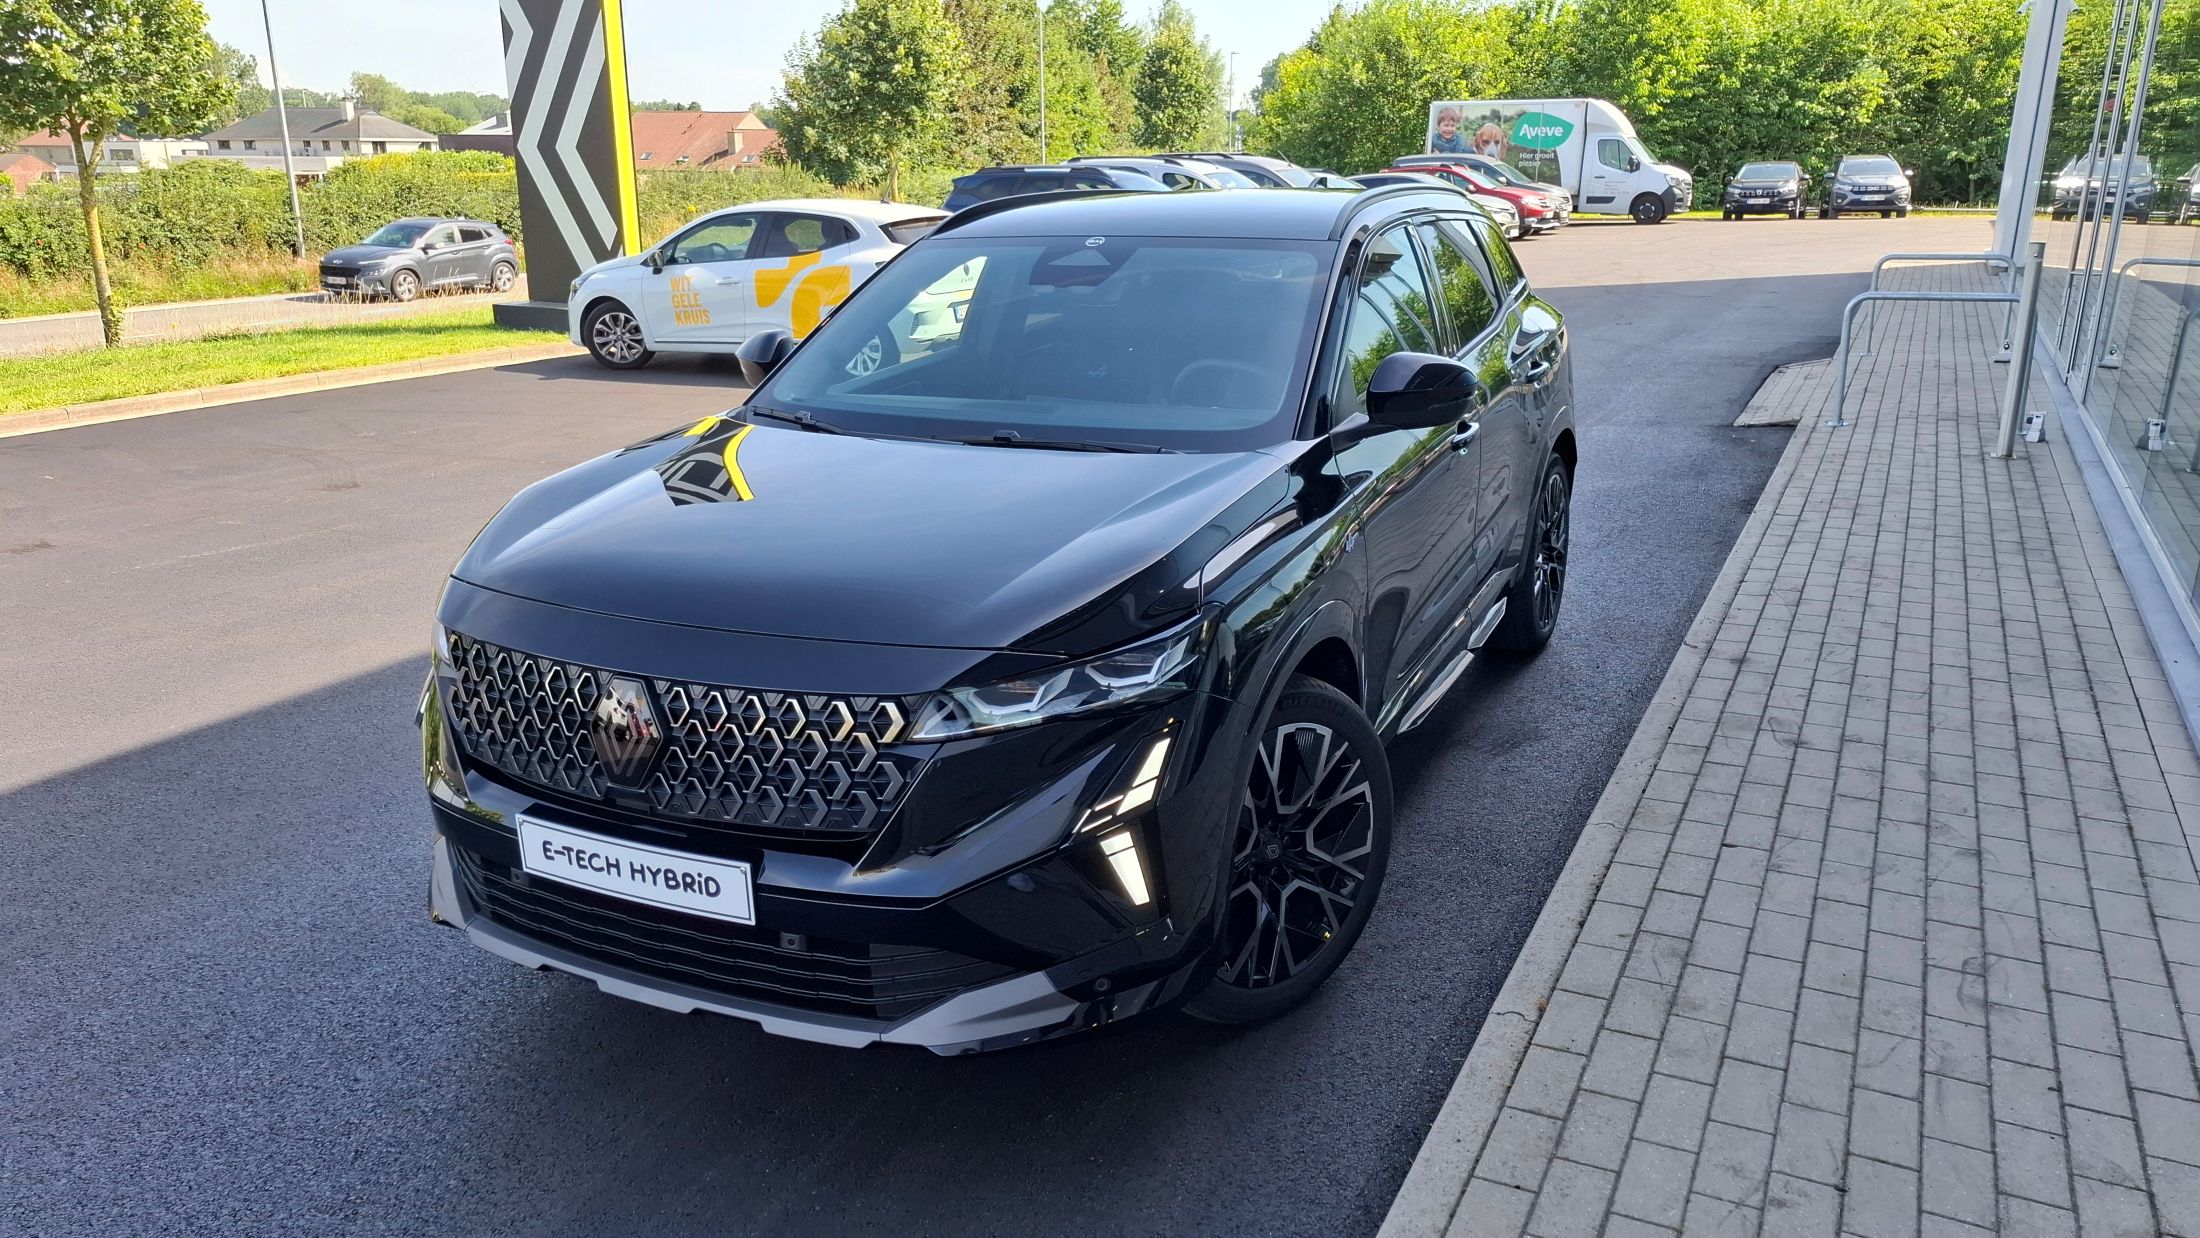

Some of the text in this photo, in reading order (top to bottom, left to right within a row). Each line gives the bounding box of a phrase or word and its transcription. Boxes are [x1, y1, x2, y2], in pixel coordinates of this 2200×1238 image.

[1519, 124, 1564, 140] Aveve
[1520, 152, 1555, 161] Hier groeit
[670, 276, 693, 293] WIT
[671, 293, 702, 309] GELE
[674, 309, 712, 326] KRUIS
[542, 840, 622, 878] E-TECH
